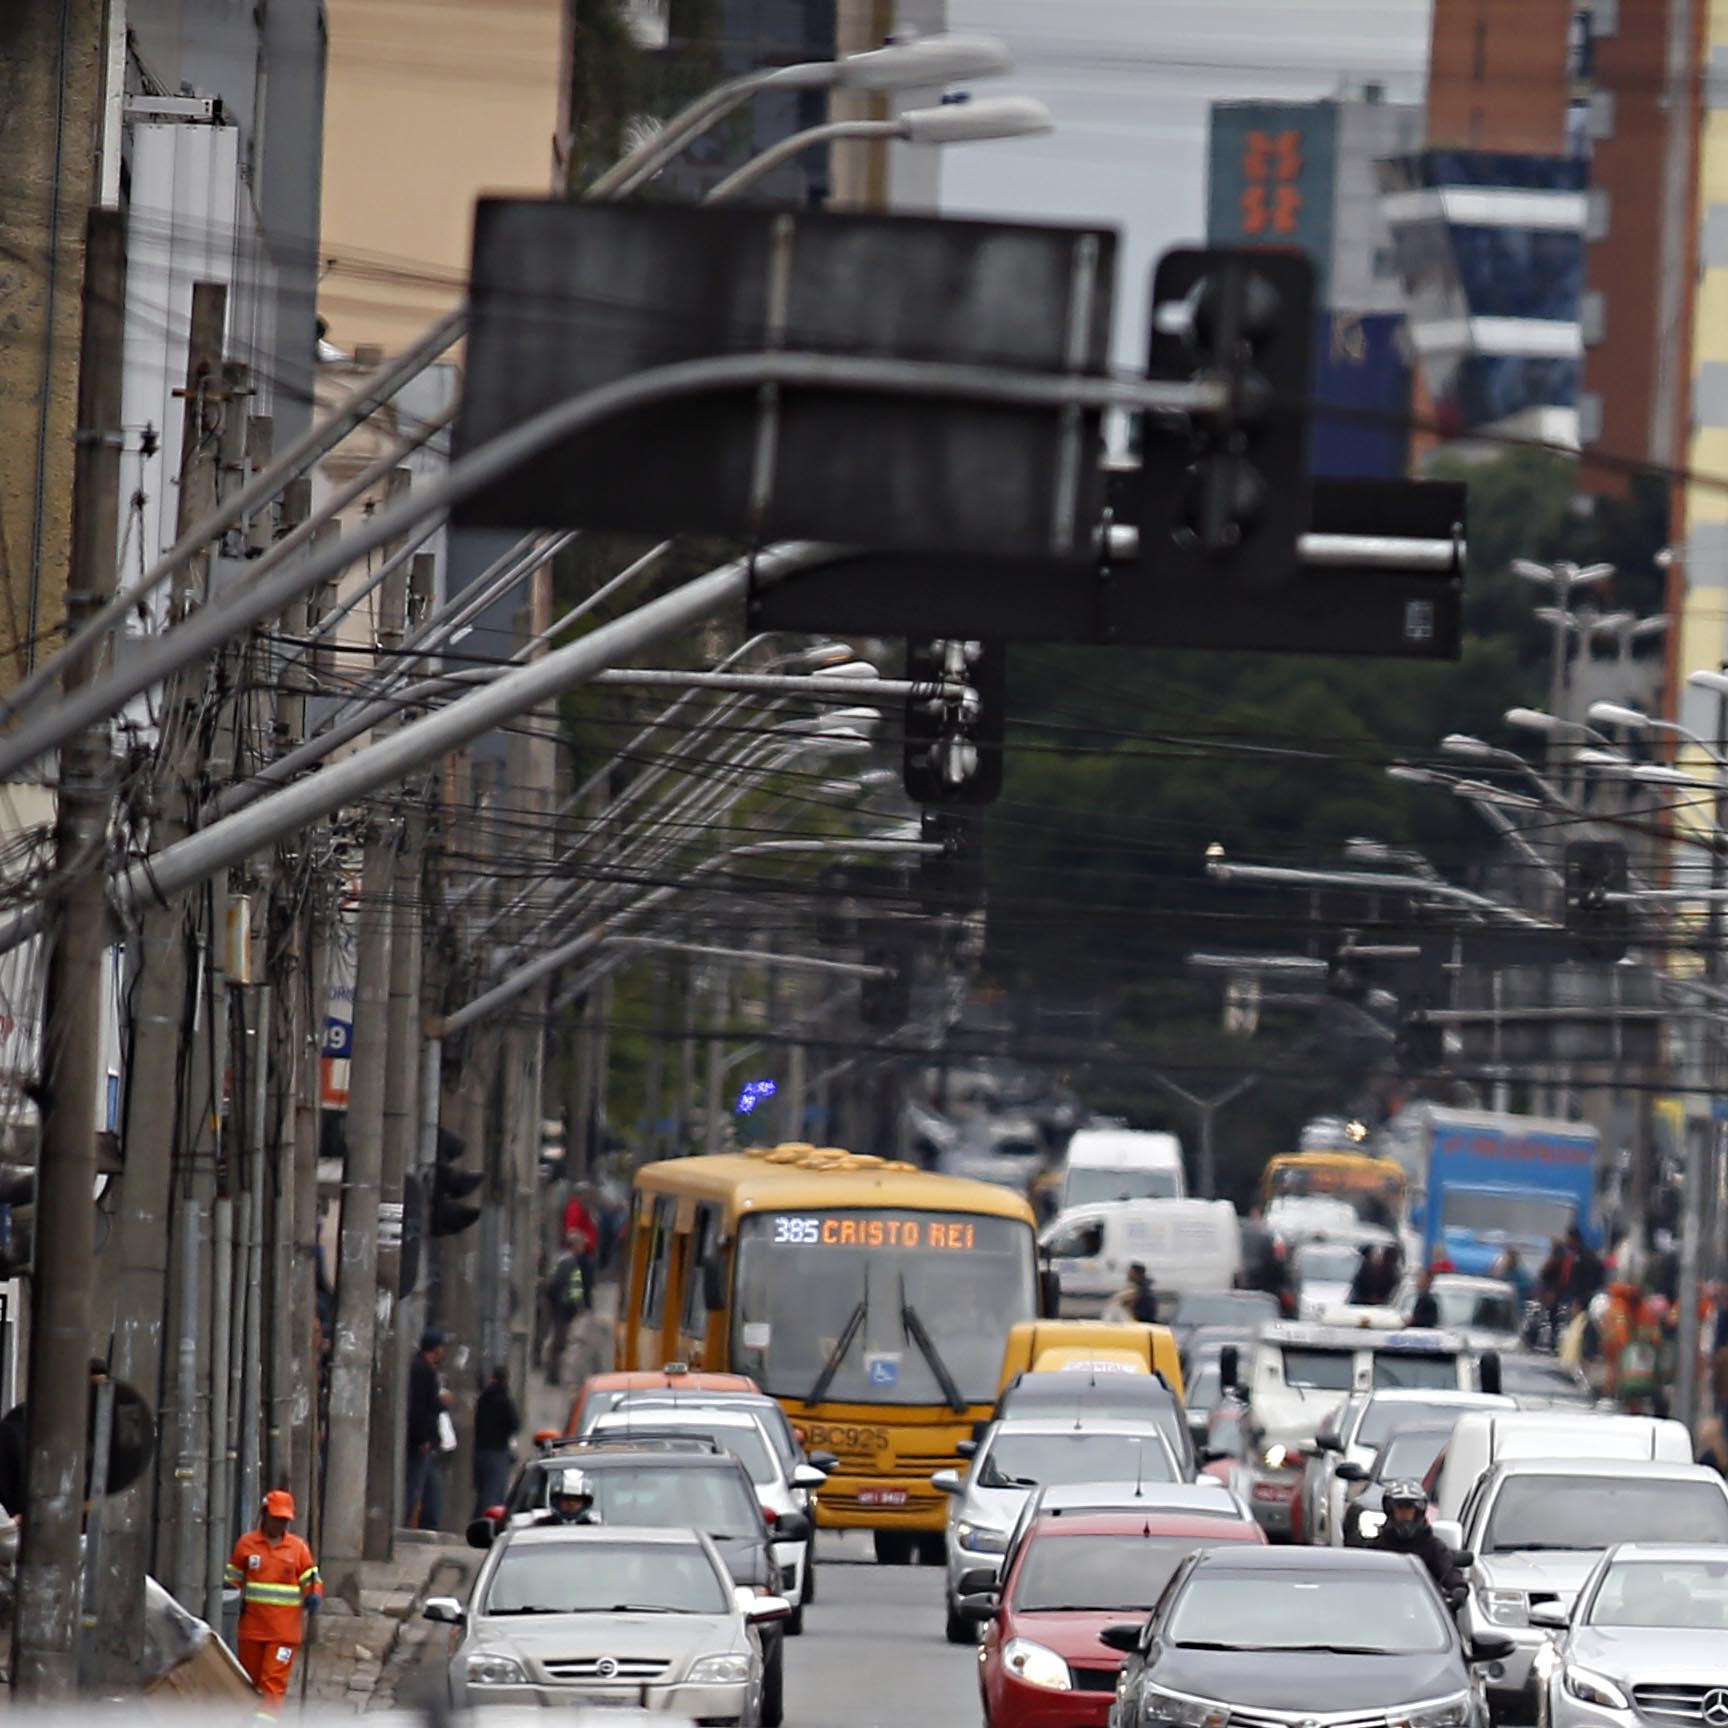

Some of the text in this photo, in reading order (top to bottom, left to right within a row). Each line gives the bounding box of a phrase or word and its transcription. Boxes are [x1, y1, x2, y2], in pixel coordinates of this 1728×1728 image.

[774, 1217, 975, 1249] 385 CRISTO REI
